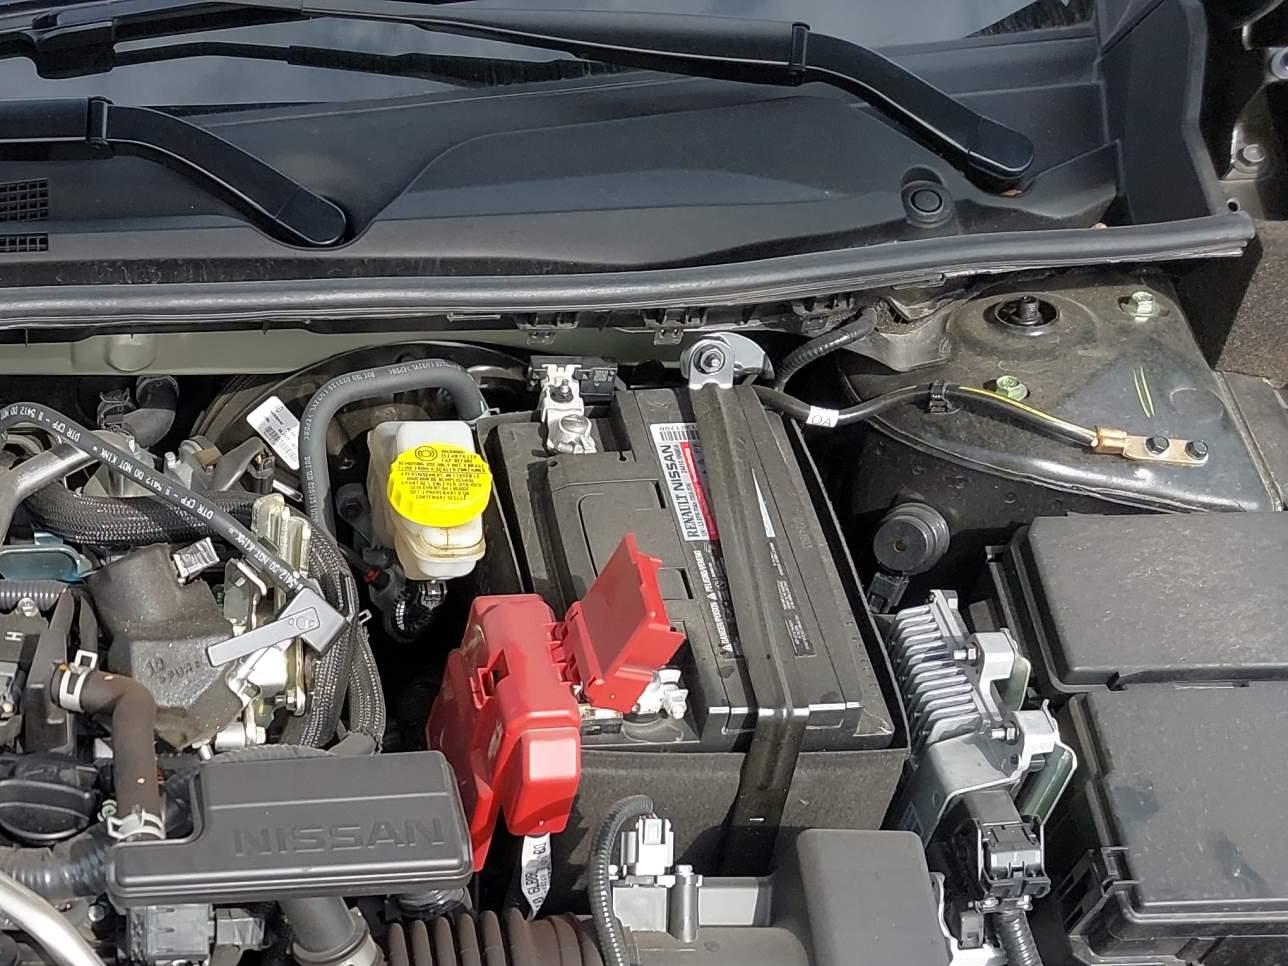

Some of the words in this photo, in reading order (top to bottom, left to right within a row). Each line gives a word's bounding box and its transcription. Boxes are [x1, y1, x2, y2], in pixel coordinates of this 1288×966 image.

[660, 444, 685, 492] NISSAN
[197, 503, 214, 520] DTR
[676, 494, 700, 538] RENAULT
[231, 818, 446, 858] NISSAN
